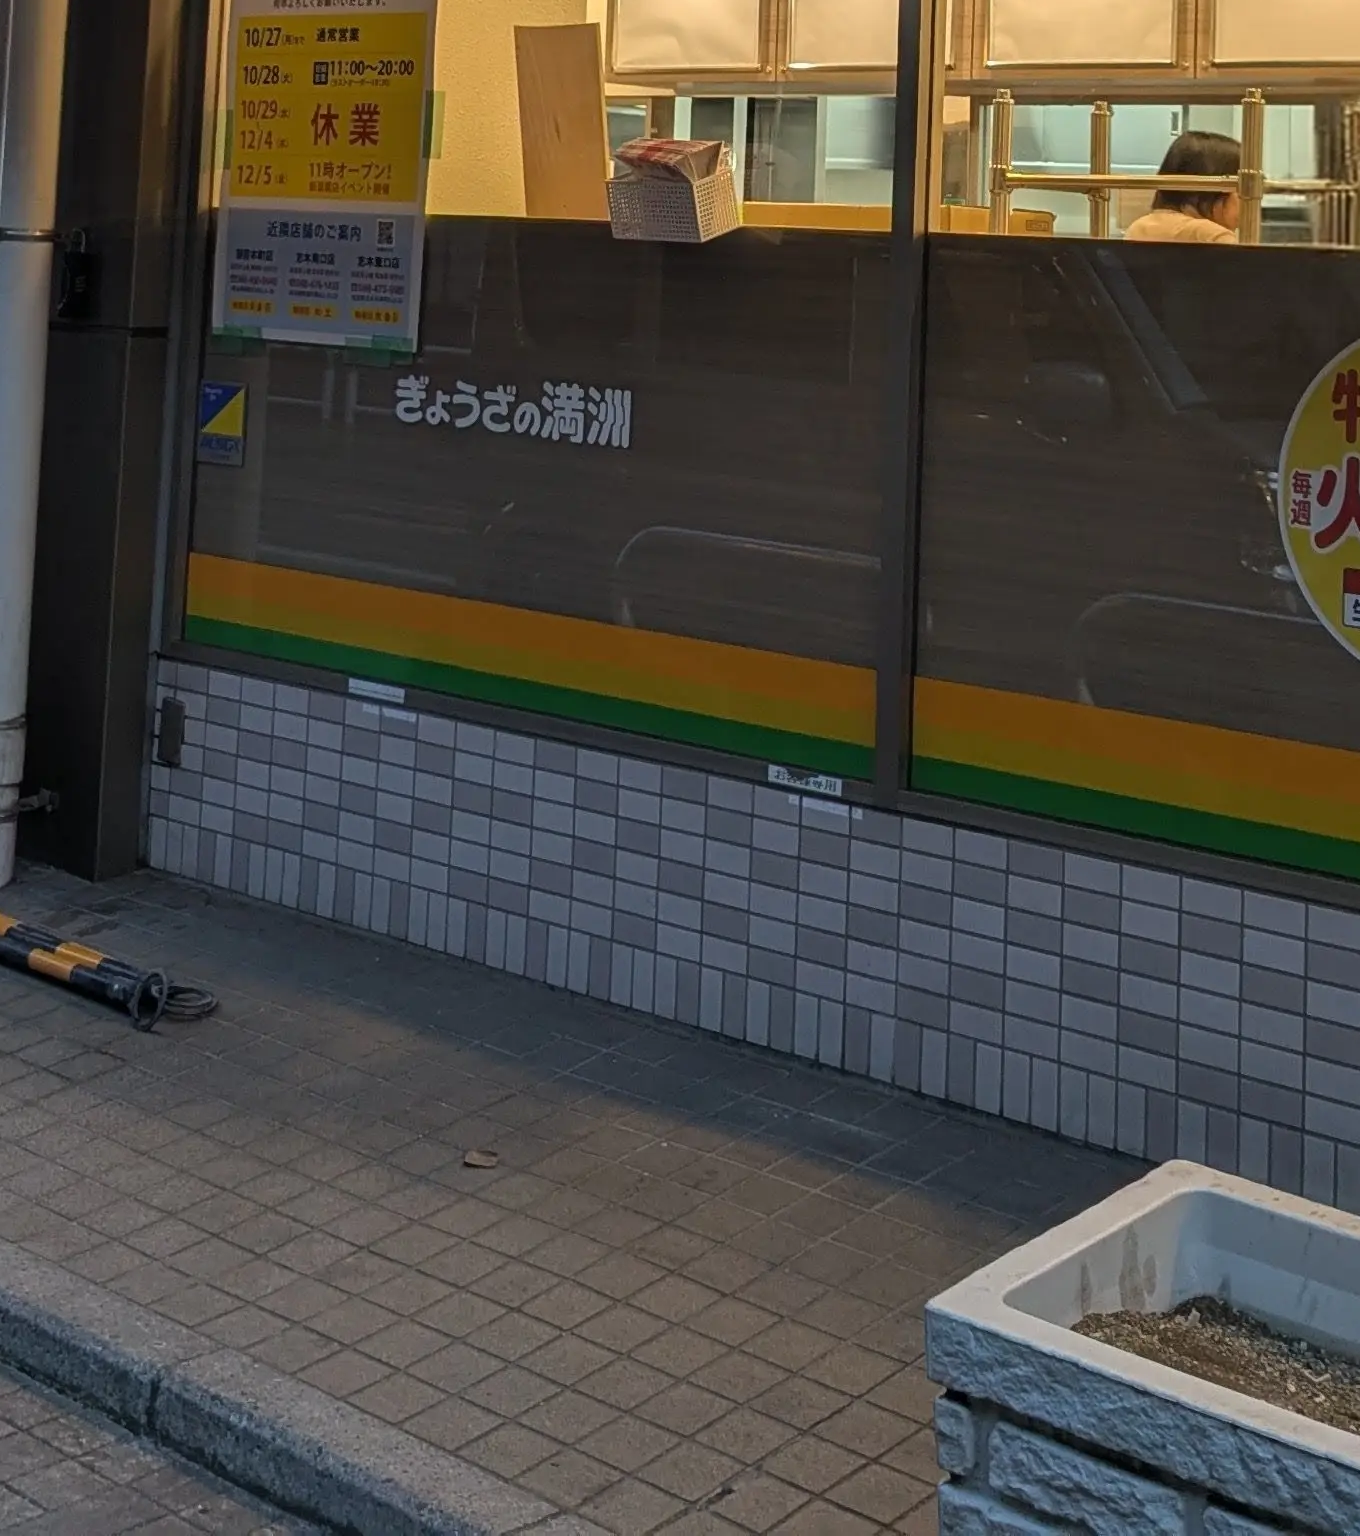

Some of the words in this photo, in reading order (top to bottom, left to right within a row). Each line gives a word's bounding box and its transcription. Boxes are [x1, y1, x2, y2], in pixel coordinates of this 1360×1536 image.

[310, 102, 381, 147] 休業
[396, 374, 632, 448] ぎょうざの満洲
[1291, 470, 1312, 527] 毎週
